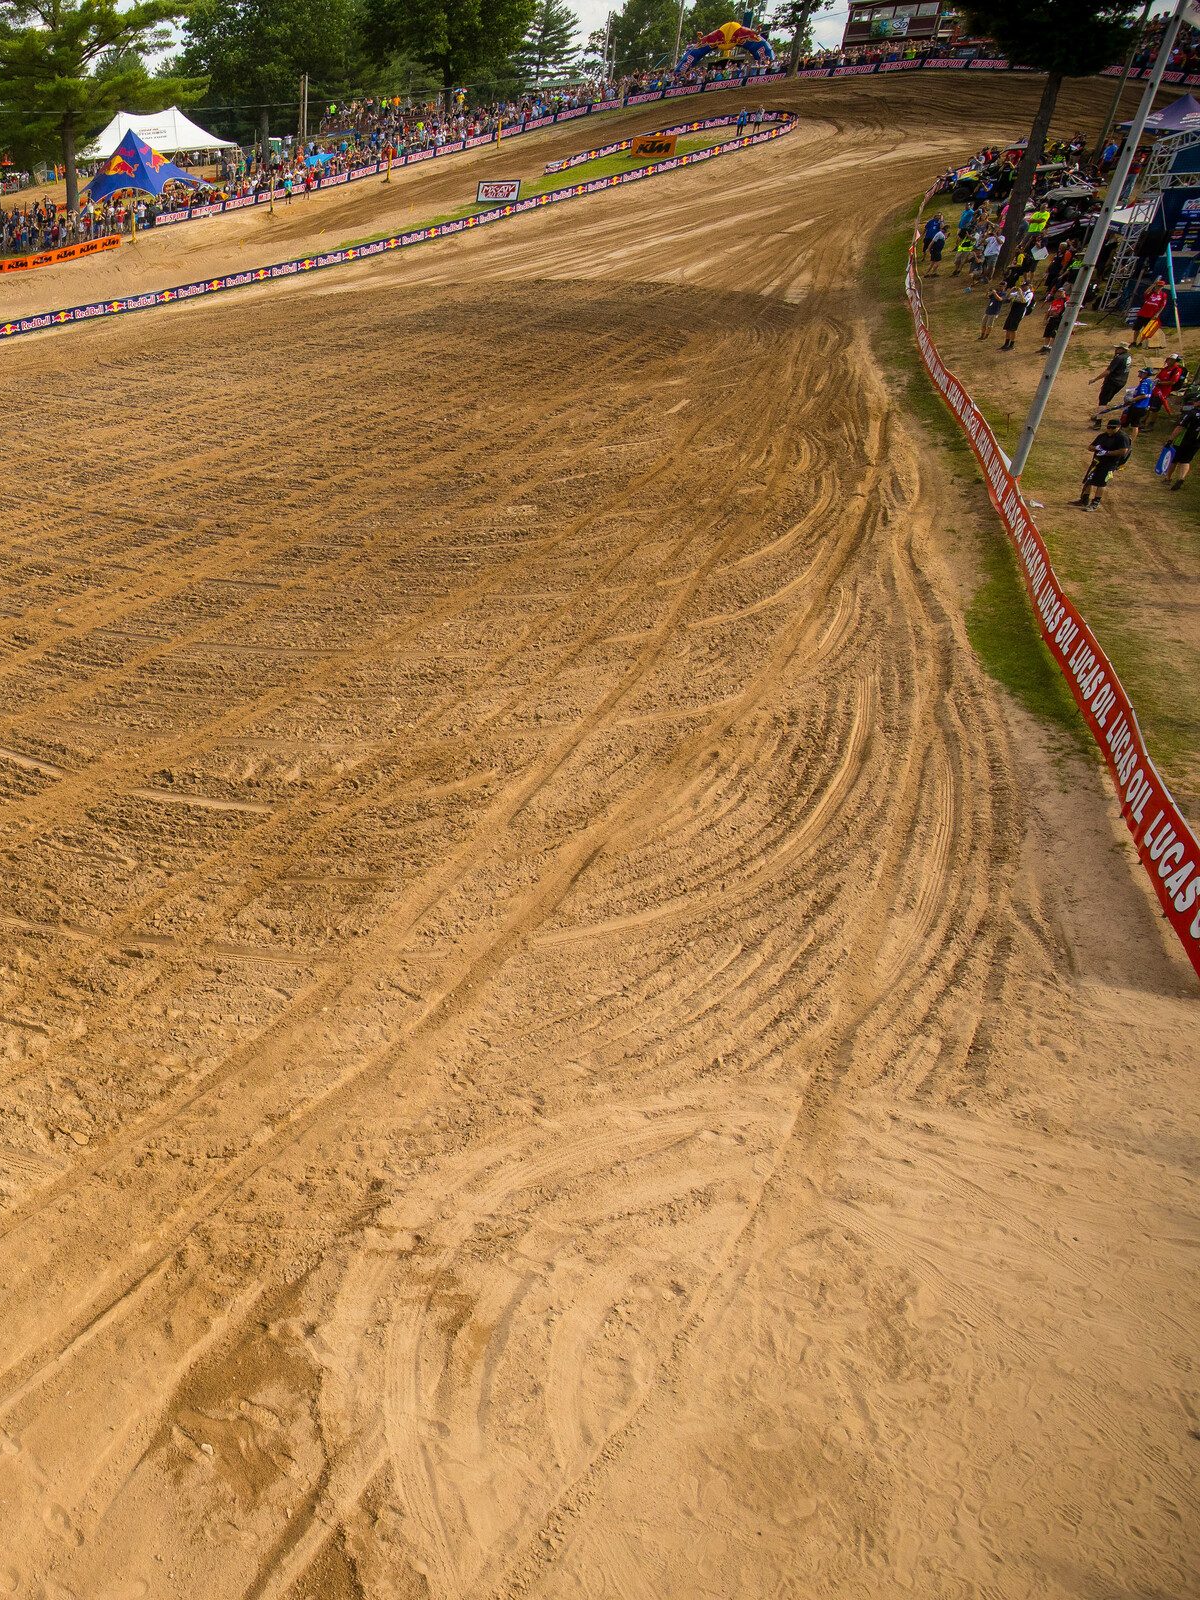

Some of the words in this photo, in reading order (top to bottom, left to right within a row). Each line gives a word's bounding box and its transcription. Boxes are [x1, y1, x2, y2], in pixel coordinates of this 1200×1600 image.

[636, 141, 672, 154] KTM
[1020, 530, 1042, 578] LUCAS
[1037, 580, 1066, 634] LUCAS
[1054, 616, 1079, 656] OIL
[1068, 639, 1104, 700] LUCAS
[1091, 682, 1116, 728] OIL
[1106, 711, 1137, 786] LUCAS
[1126, 768, 1154, 825] OIL
[1144, 810, 1200, 912] LUCAS
